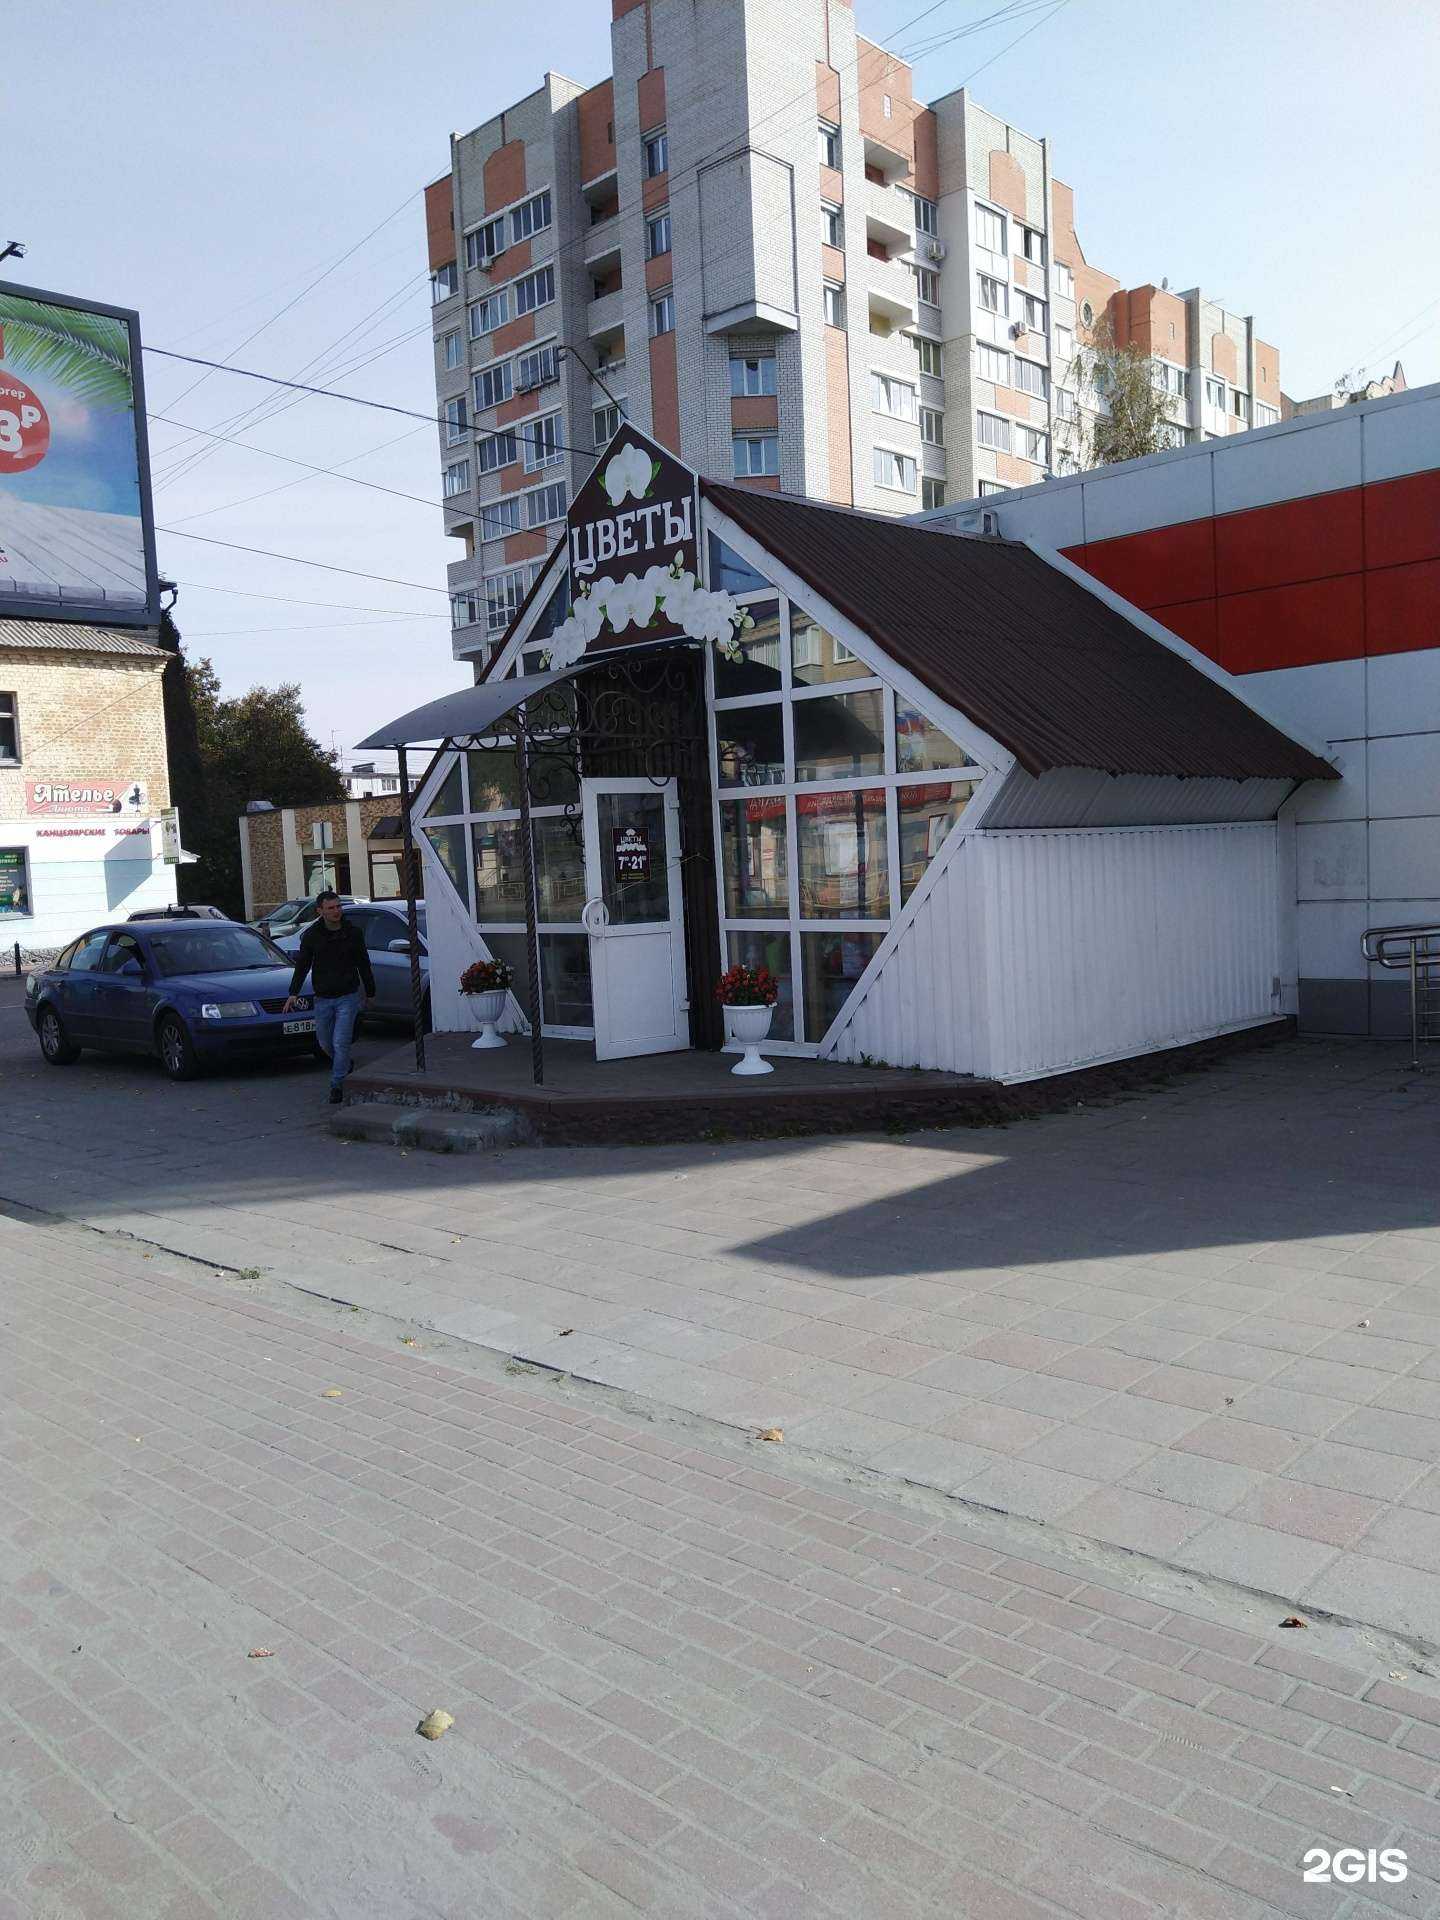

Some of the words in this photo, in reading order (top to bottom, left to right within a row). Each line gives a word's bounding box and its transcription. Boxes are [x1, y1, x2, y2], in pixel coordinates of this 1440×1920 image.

[570, 496, 693, 578] ЦВЕТЫ
[34, 783, 115, 804] Ателье
[36, 828, 106, 838] КАНЦЕЛЯРСКИЕ
[113, 827, 150, 836] ТОВАРЫ
